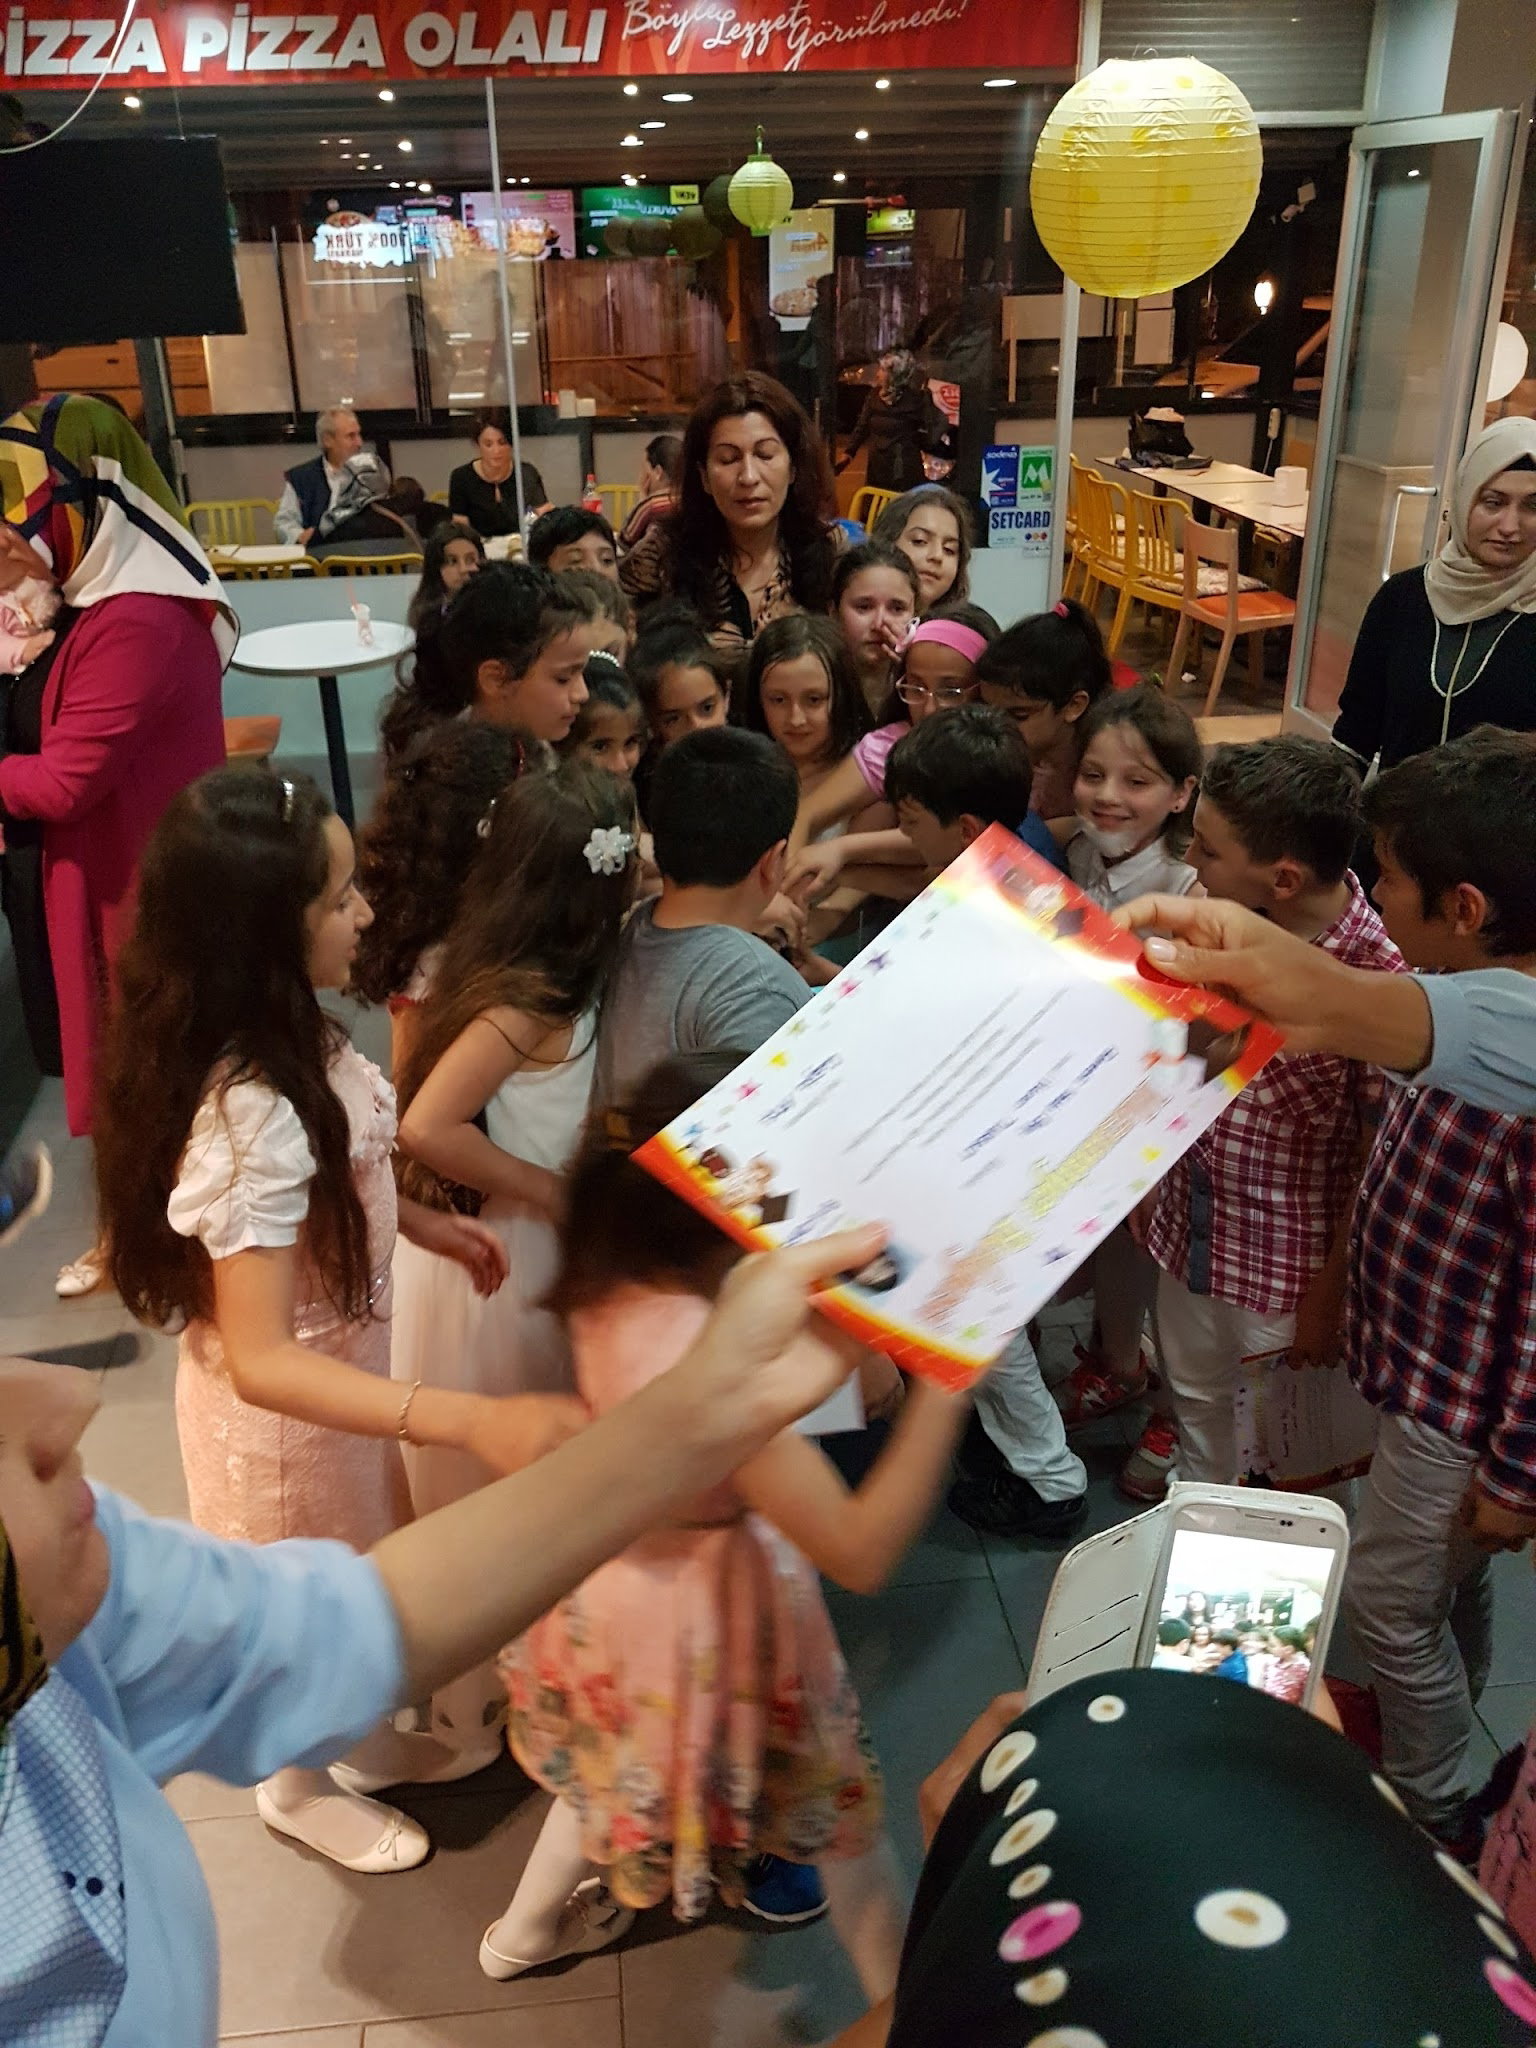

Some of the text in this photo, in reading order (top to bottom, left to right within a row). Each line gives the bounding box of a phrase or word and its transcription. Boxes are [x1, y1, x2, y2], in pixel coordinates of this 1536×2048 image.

[0, 2, 607, 76] İZZA PİZZA OLALI
[703, 3, 809, 59] Lezzet
[991, 511, 1051, 529] SETCARD
